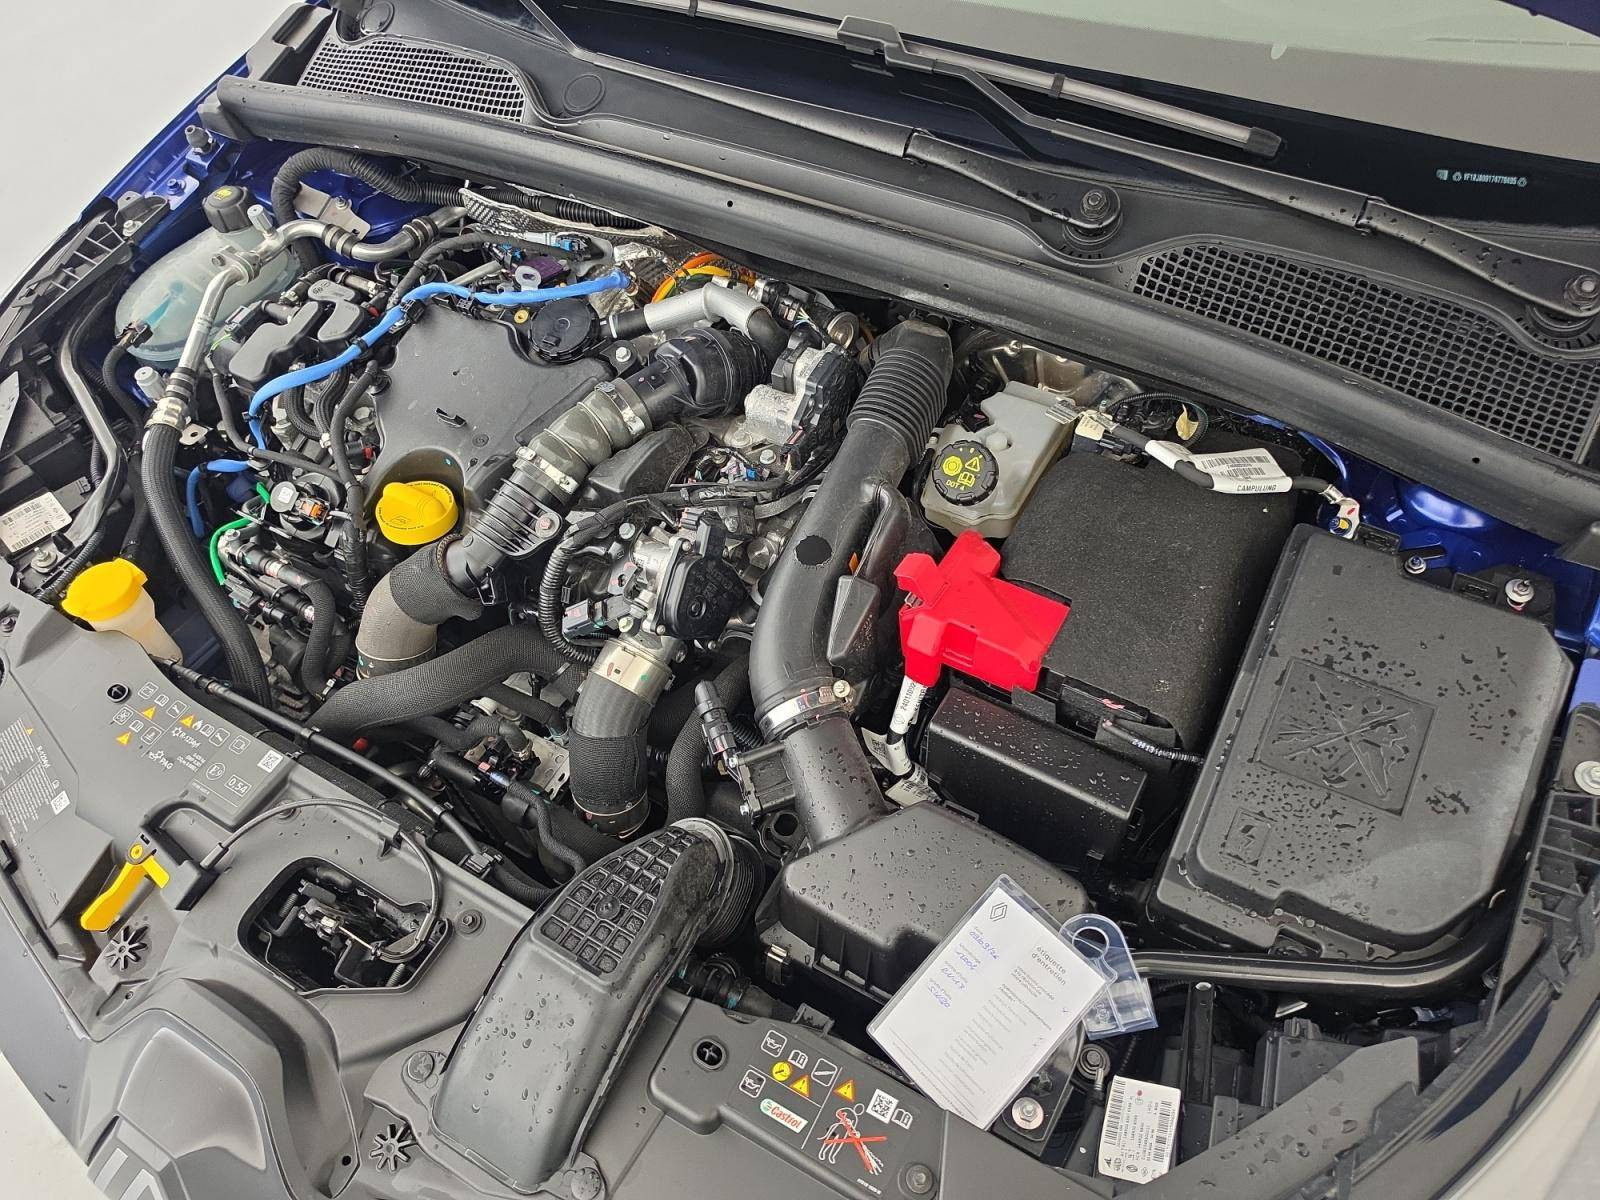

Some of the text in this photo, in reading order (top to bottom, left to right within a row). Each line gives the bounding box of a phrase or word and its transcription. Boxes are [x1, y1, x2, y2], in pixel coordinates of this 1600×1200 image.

[945, 479, 960, 489] DOT
[1236, 484, 1277, 492] CAMPULUNG
[160, 757, 174, 770] PAG
[228, 777, 249, 794] 0,54
[771, 1106, 802, 1129] Castrol
